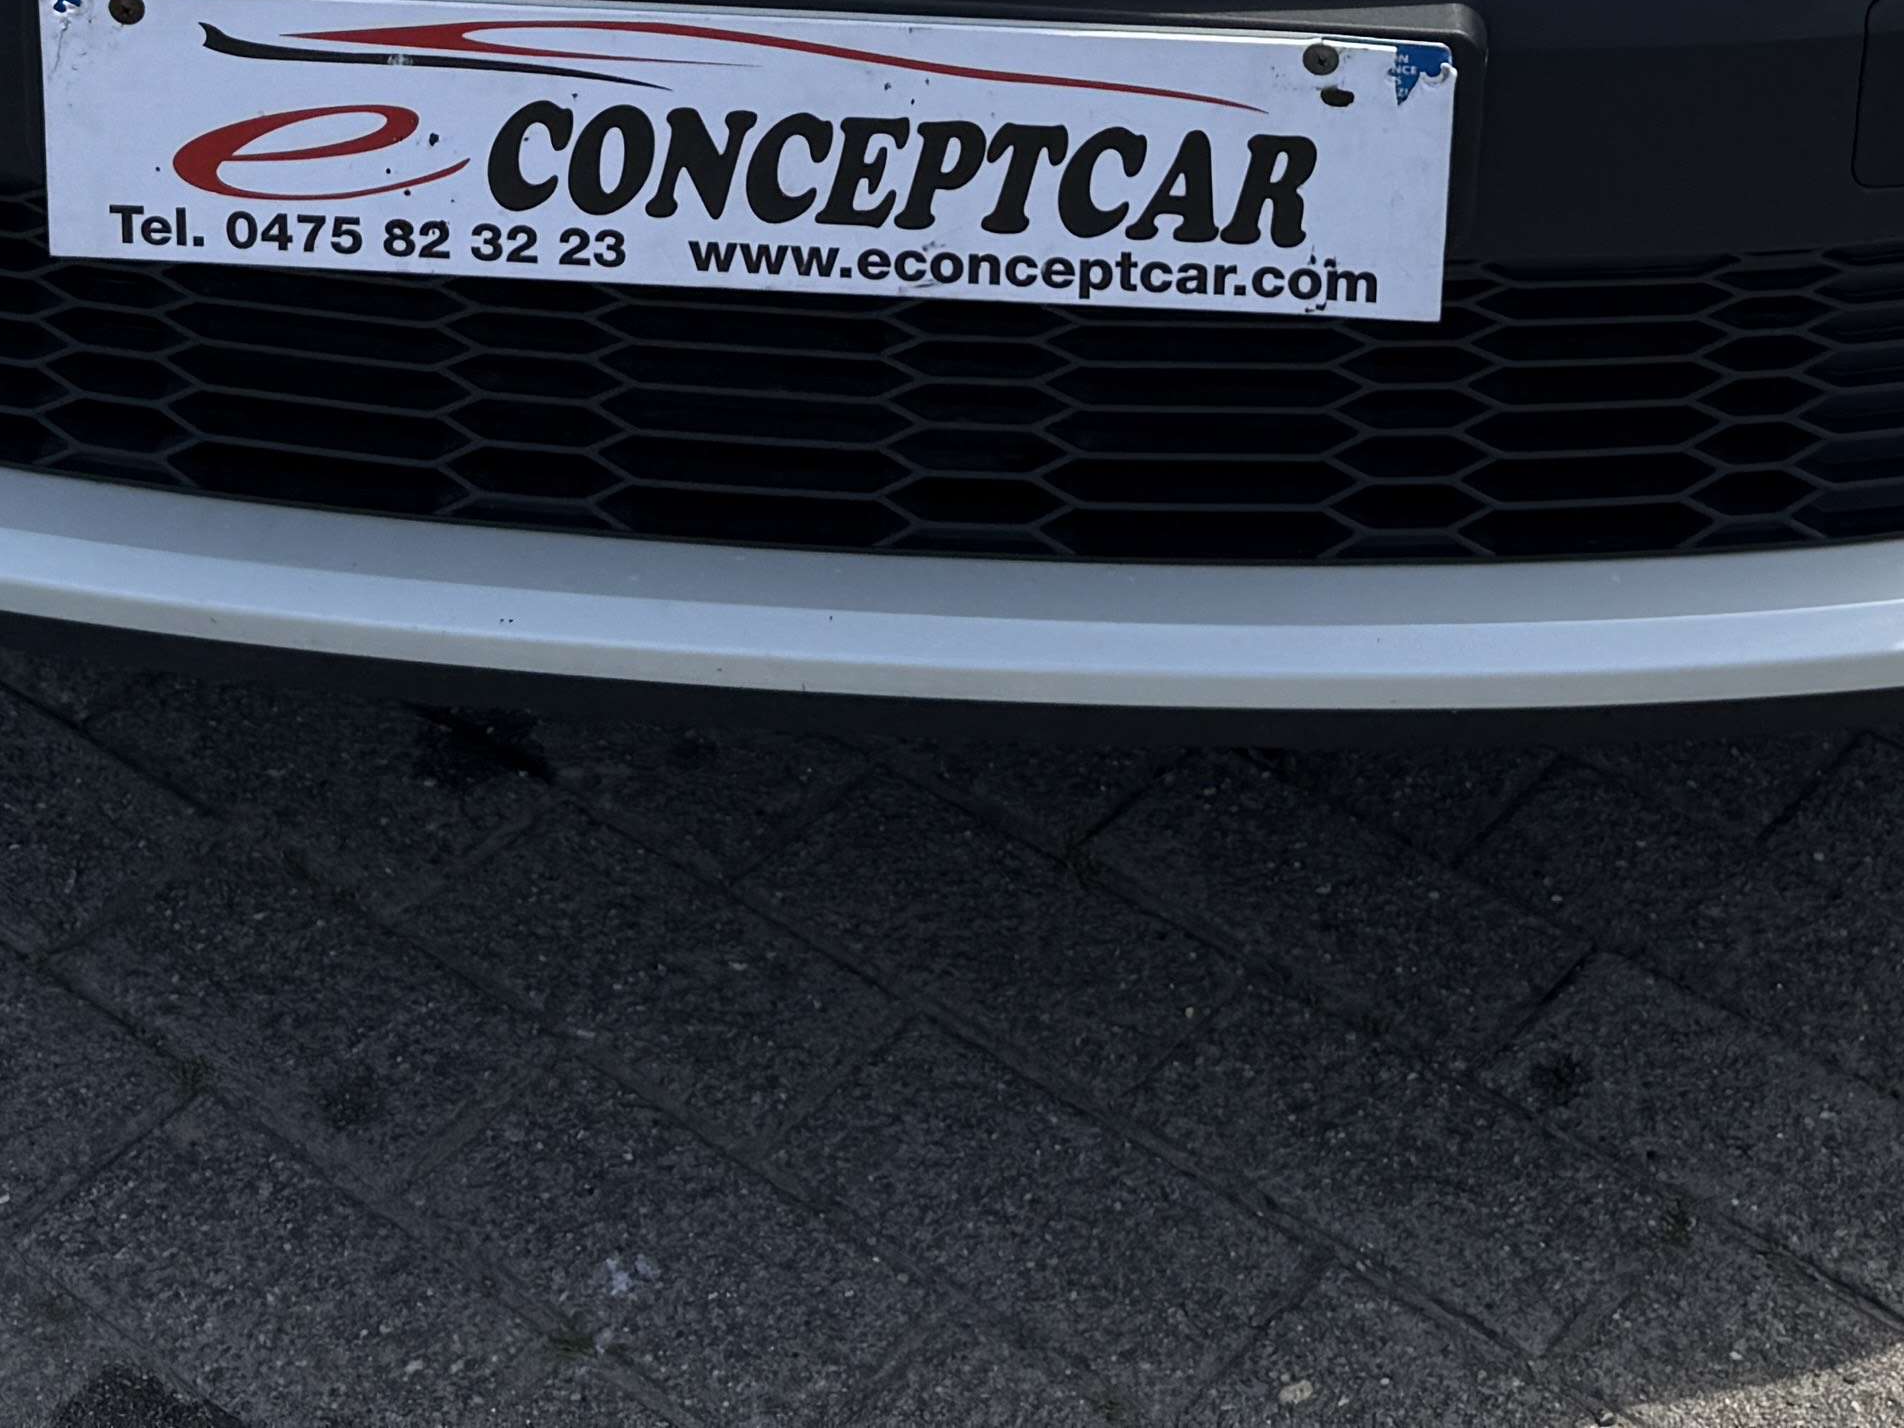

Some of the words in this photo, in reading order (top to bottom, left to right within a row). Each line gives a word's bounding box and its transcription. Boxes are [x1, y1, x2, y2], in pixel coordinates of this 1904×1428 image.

[488, 100, 1317, 247] CONCEPTCAR
[109, 204, 204, 247] Tel.
[226, 211, 364, 254] 0475
[383, 219, 450, 259] 82
[471, 223, 538, 263] 32
[559, 228, 627, 267] 23
[689, 241, 1378, 303] www.econceptcar.com
